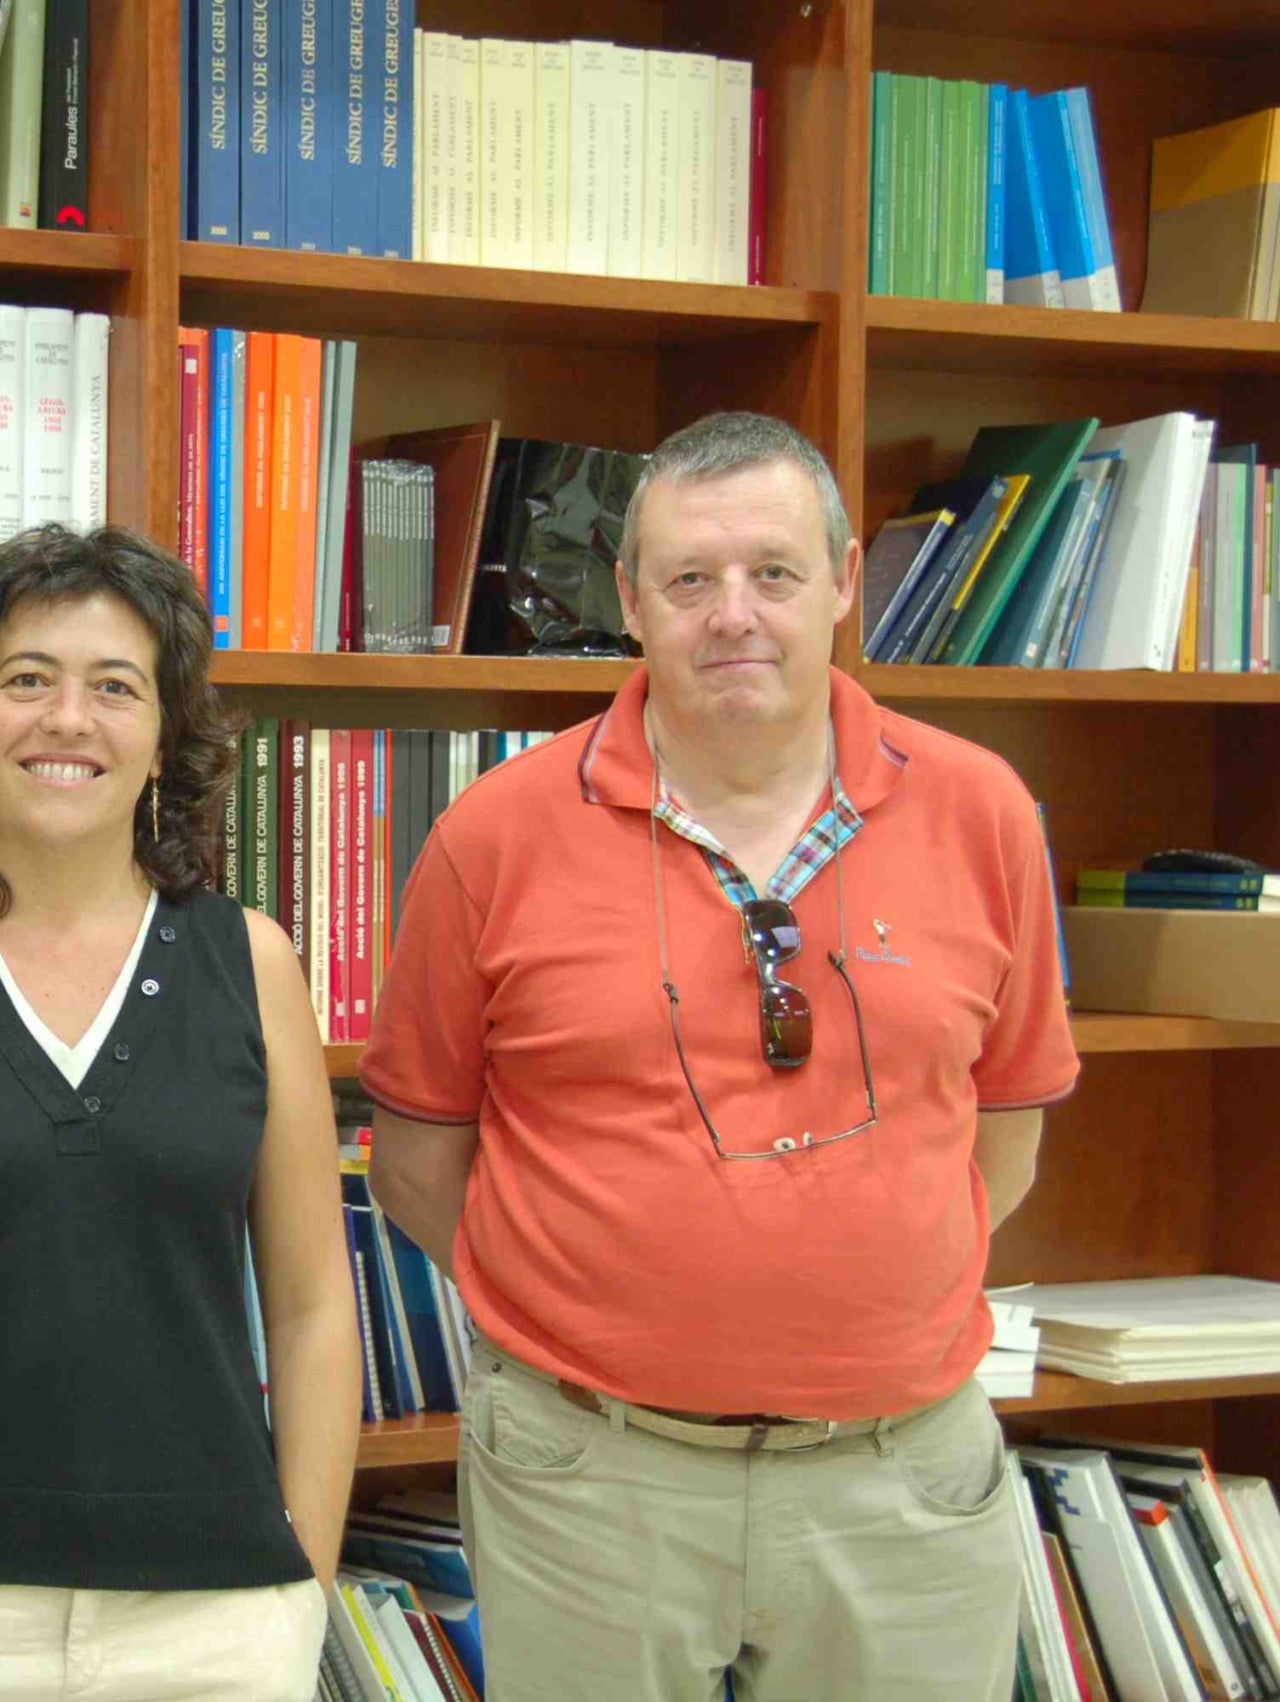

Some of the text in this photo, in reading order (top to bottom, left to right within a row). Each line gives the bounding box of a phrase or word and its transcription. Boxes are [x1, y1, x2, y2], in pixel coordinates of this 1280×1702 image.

[212, 57, 226, 82] DE
[253, 62, 268, 87] DE
[302, 69, 316, 94] DE
[349, 74, 363, 99] DE
[384, 78, 398, 104] DE
[208, 87, 226, 149] SÍNDIC
[250, 91, 268, 154] SÍNDIC
[299, 98, 316, 161] SÍNDIC
[346, 103, 363, 165] SÍNDIC
[381, 107, 398, 168] SÍNDIC
[64, 106, 79, 170] Paraules
[89, 375, 101, 453] CATALUNYA
[89, 457, 101, 475] DE
[257, 737, 268, 767] 1991
[257, 775, 268, 837] CATALUNYA
[337, 793, 347, 849] Catalunya
[357, 791, 367, 846] Catalunya
[226, 835, 237, 849] DE
[257, 838, 268, 853] DE
[292, 735, 304, 955] ACCIÓ DEL GOVERN DE CATALUNYA 1993
[337, 851, 346, 865] de
[357, 849, 366, 863] de
[226, 851, 237, 897] GOVERN
[257, 856, 268, 899] GOVERN
[337, 868, 346, 907] Govern
[357, 865, 365, 905] Govern
[356, 908, 365, 925] del
[356, 927, 365, 959] Acció
